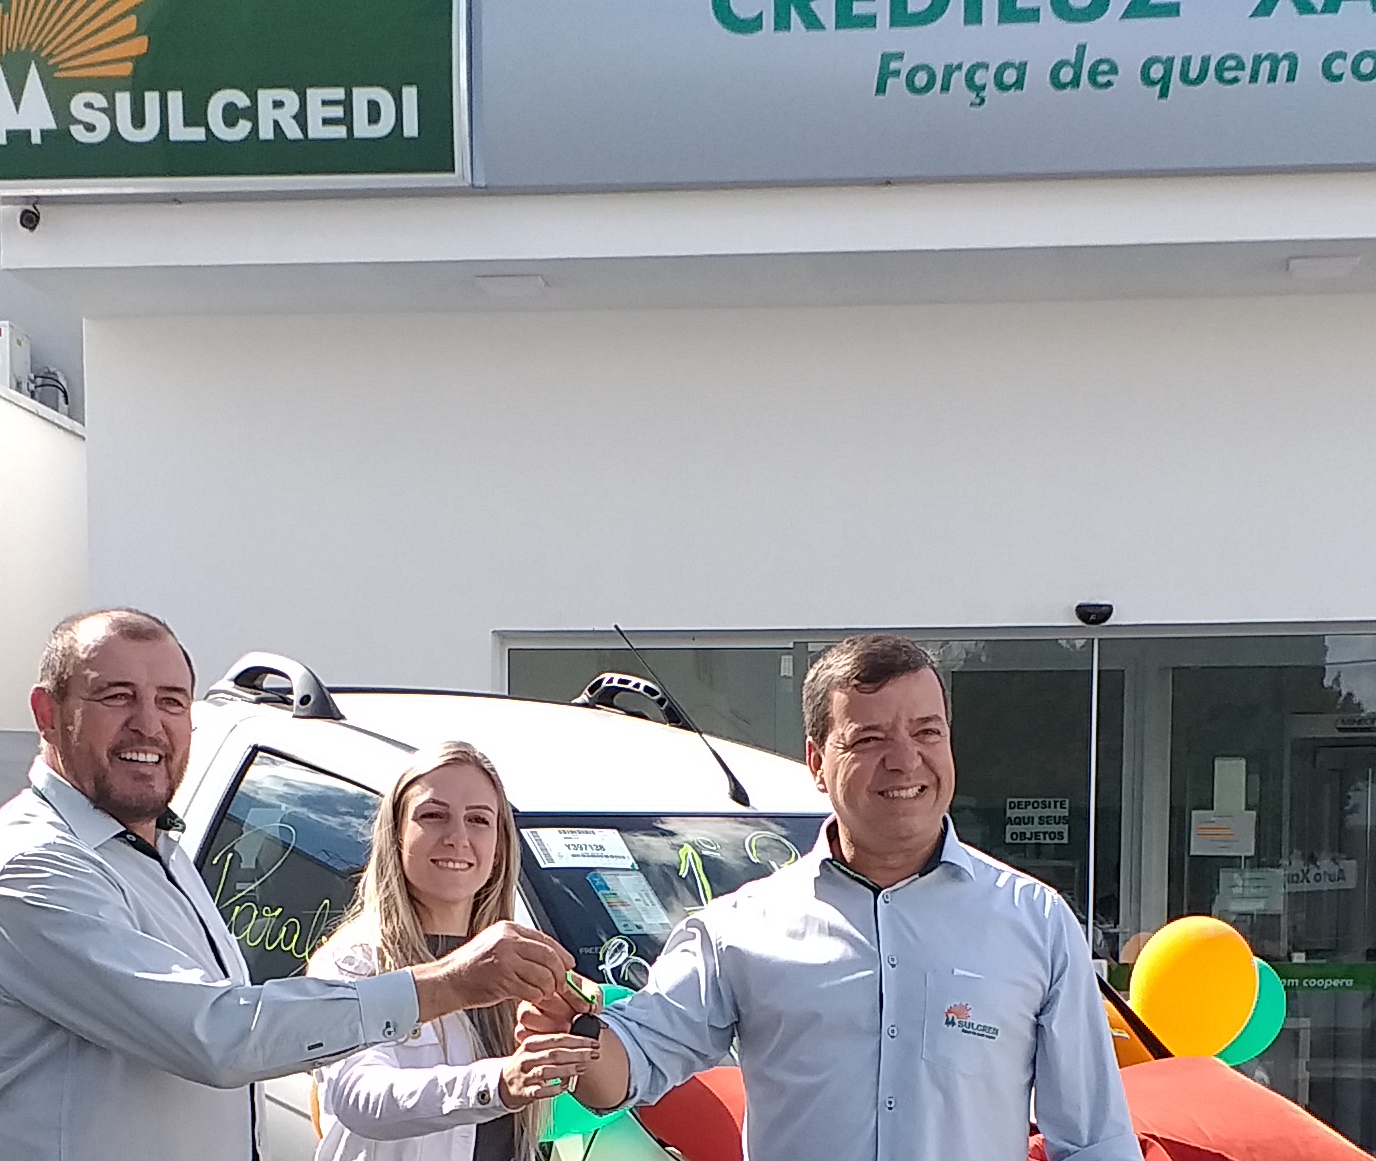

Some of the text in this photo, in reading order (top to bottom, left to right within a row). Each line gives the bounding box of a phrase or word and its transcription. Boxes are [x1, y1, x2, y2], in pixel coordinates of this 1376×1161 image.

[874, 50, 1028, 108] Força
[1049, 42, 1119, 92] de
[1140, 50, 1299, 100] quem
[68, 84, 420, 144] SULCREDI
[1008, 800, 1067, 810] DEPOSITE
[1005, 815, 1069, 826] AQUI SEUS
[1010, 831, 1065, 841] OBJETOS
[1302, 978, 1354, 990] coopera
